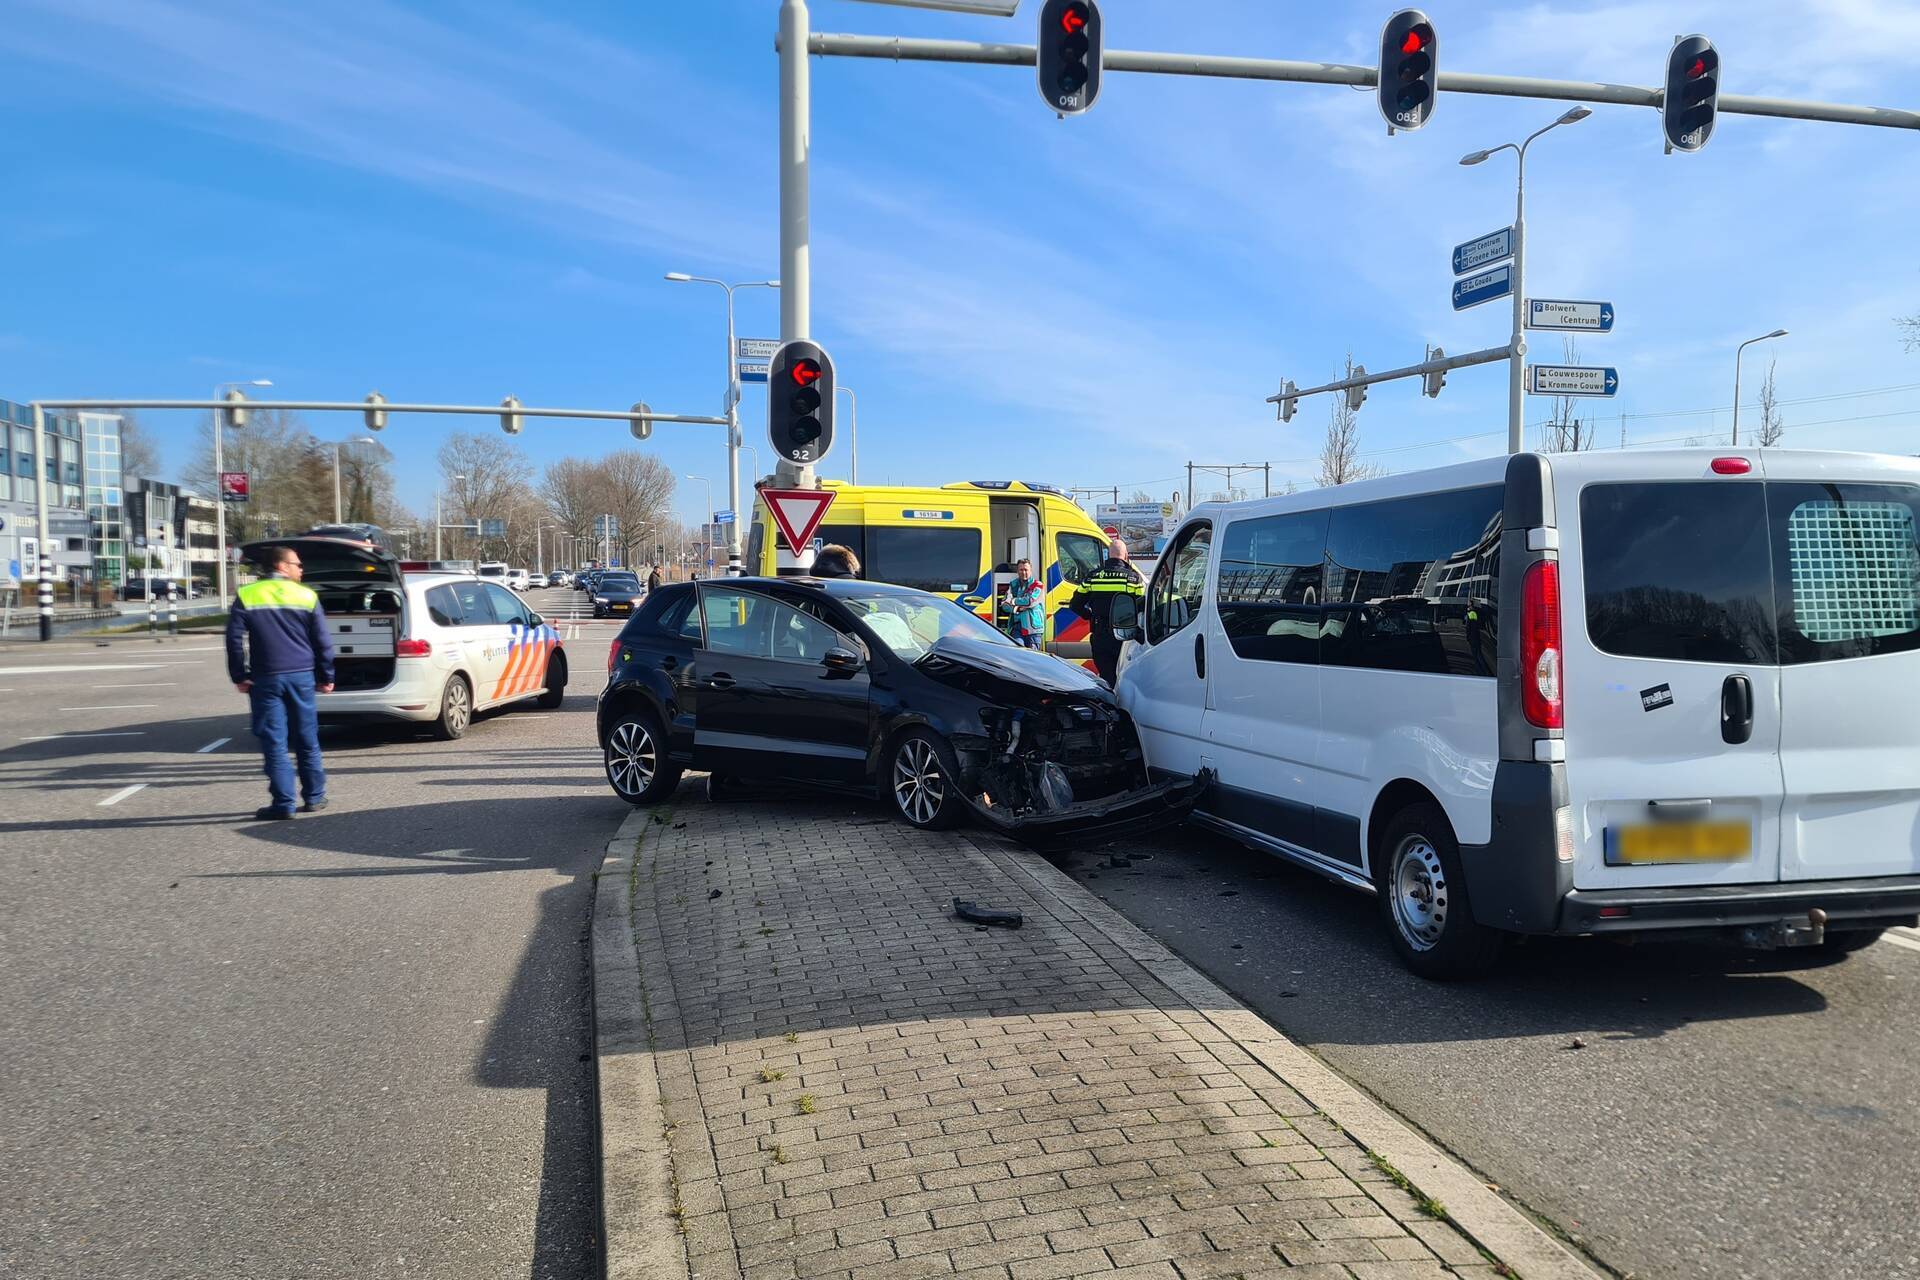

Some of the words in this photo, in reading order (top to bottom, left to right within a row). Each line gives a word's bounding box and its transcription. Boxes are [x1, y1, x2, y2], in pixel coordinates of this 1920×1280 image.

[1396, 112, 1418, 123] 08.2
[1477, 237, 1501, 250] Centrum
[1468, 252, 1489, 264] Groene
[1490, 246, 1504, 256] Hart
[1474, 276, 1492, 287] Gouda
[1544, 304, 1577, 312] Bolwerk
[1560, 316, 1600, 325] (Centrum)
[1548, 370, 1598, 378] Gouwespoor
[1580, 382, 1604, 390] Gouwe
[792, 449, 809, 460] 9.2
